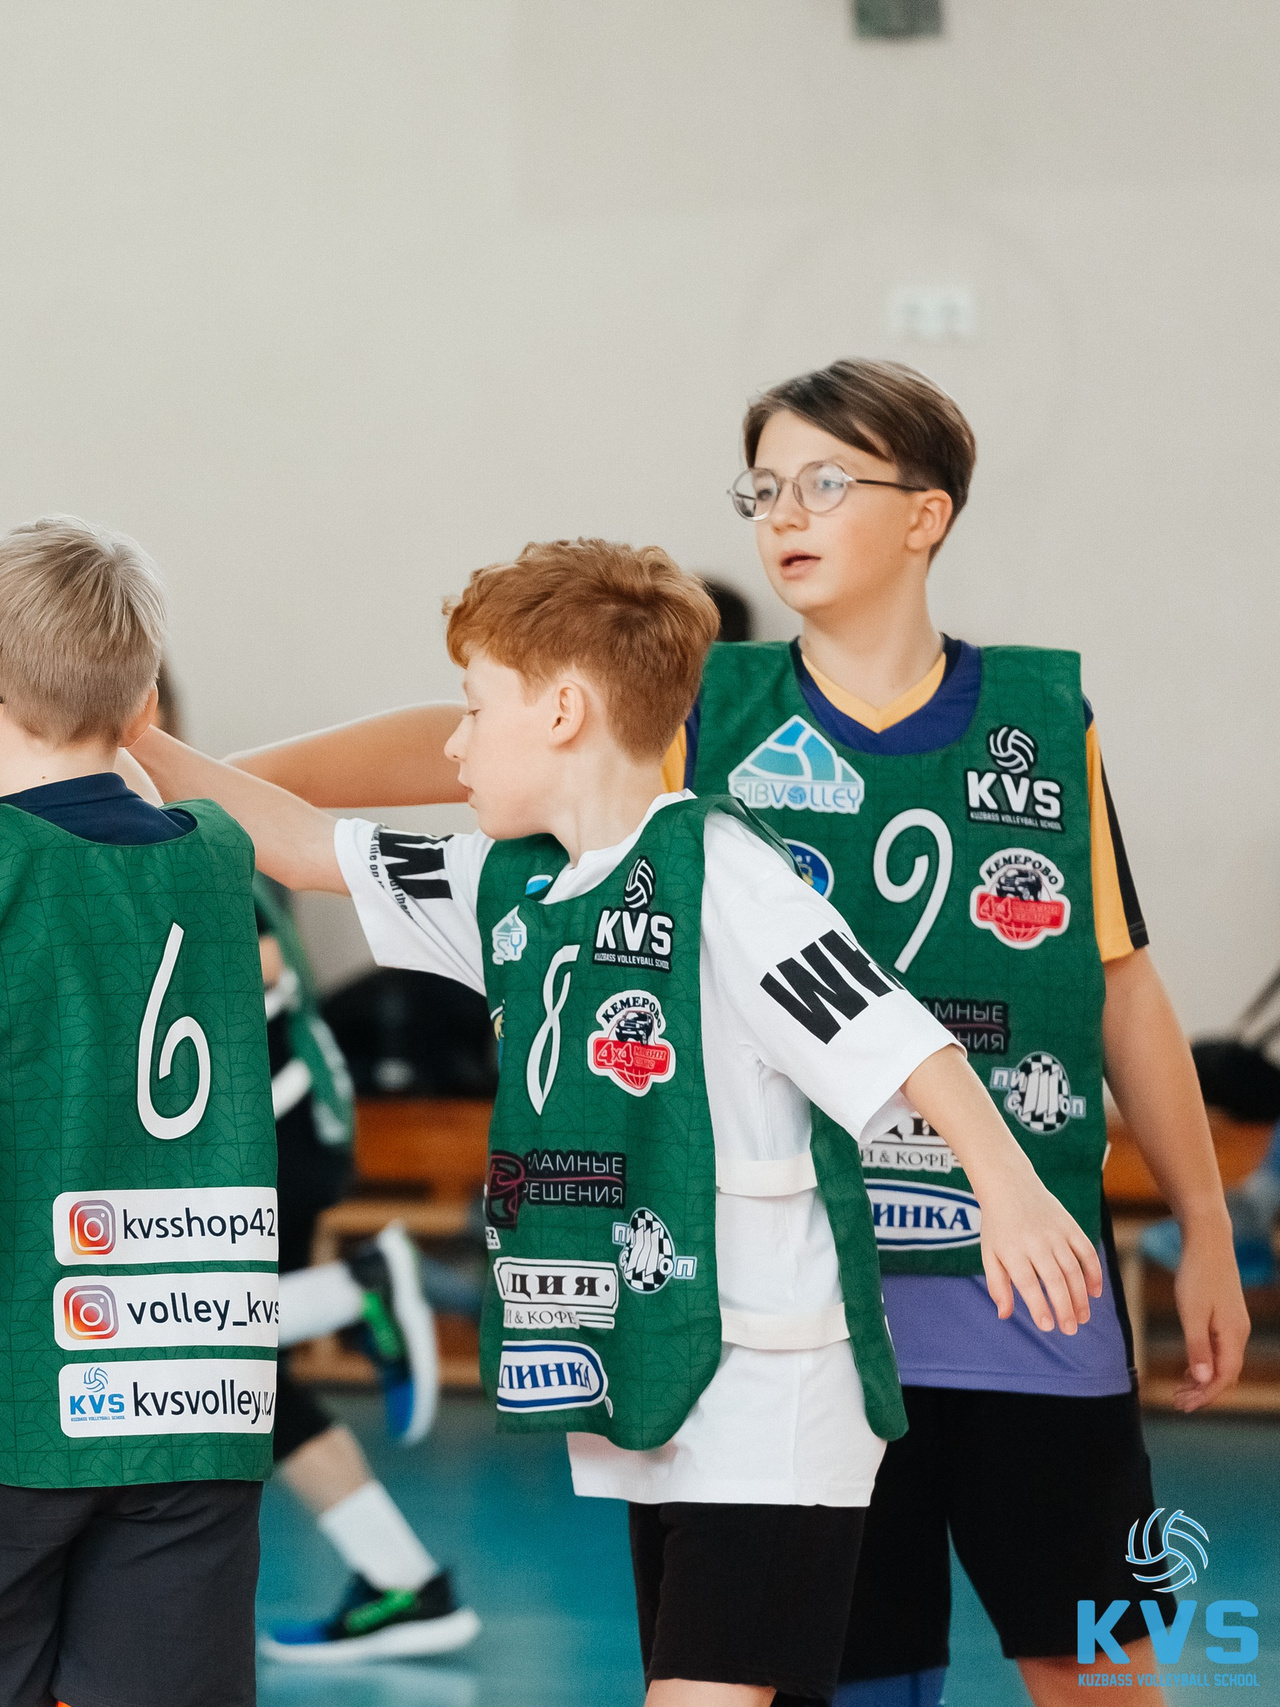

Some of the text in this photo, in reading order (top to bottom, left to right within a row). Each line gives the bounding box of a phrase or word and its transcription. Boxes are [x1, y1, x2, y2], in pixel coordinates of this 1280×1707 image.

[967, 771, 1062, 818] KVS
[985, 854, 1058, 884] КЕМЕРОВО
[873, 808, 954, 973] 9
[596, 910, 673, 956] KVS
[617, 954, 654, 967] VOLLEYBALL
[601, 997, 662, 1029] КЕМЕРОВО
[138, 922, 210, 1139] 6
[526, 945, 580, 1115] 8
[597, 1041, 633, 1067] 4x4
[896, 1150, 949, 1168] КОФЕ
[123, 1206, 276, 1244] kvsshop42
[872, 1202, 972, 1231] ИНКА
[506, 1272, 602, 1299] ЦИЯ
[127, 1291, 279, 1331] volley_kvs
[526, 1310, 577, 1325] КОФЕ
[499, 1362, 592, 1391] ЛИНКА
[70, 1393, 125, 1416] KVS
